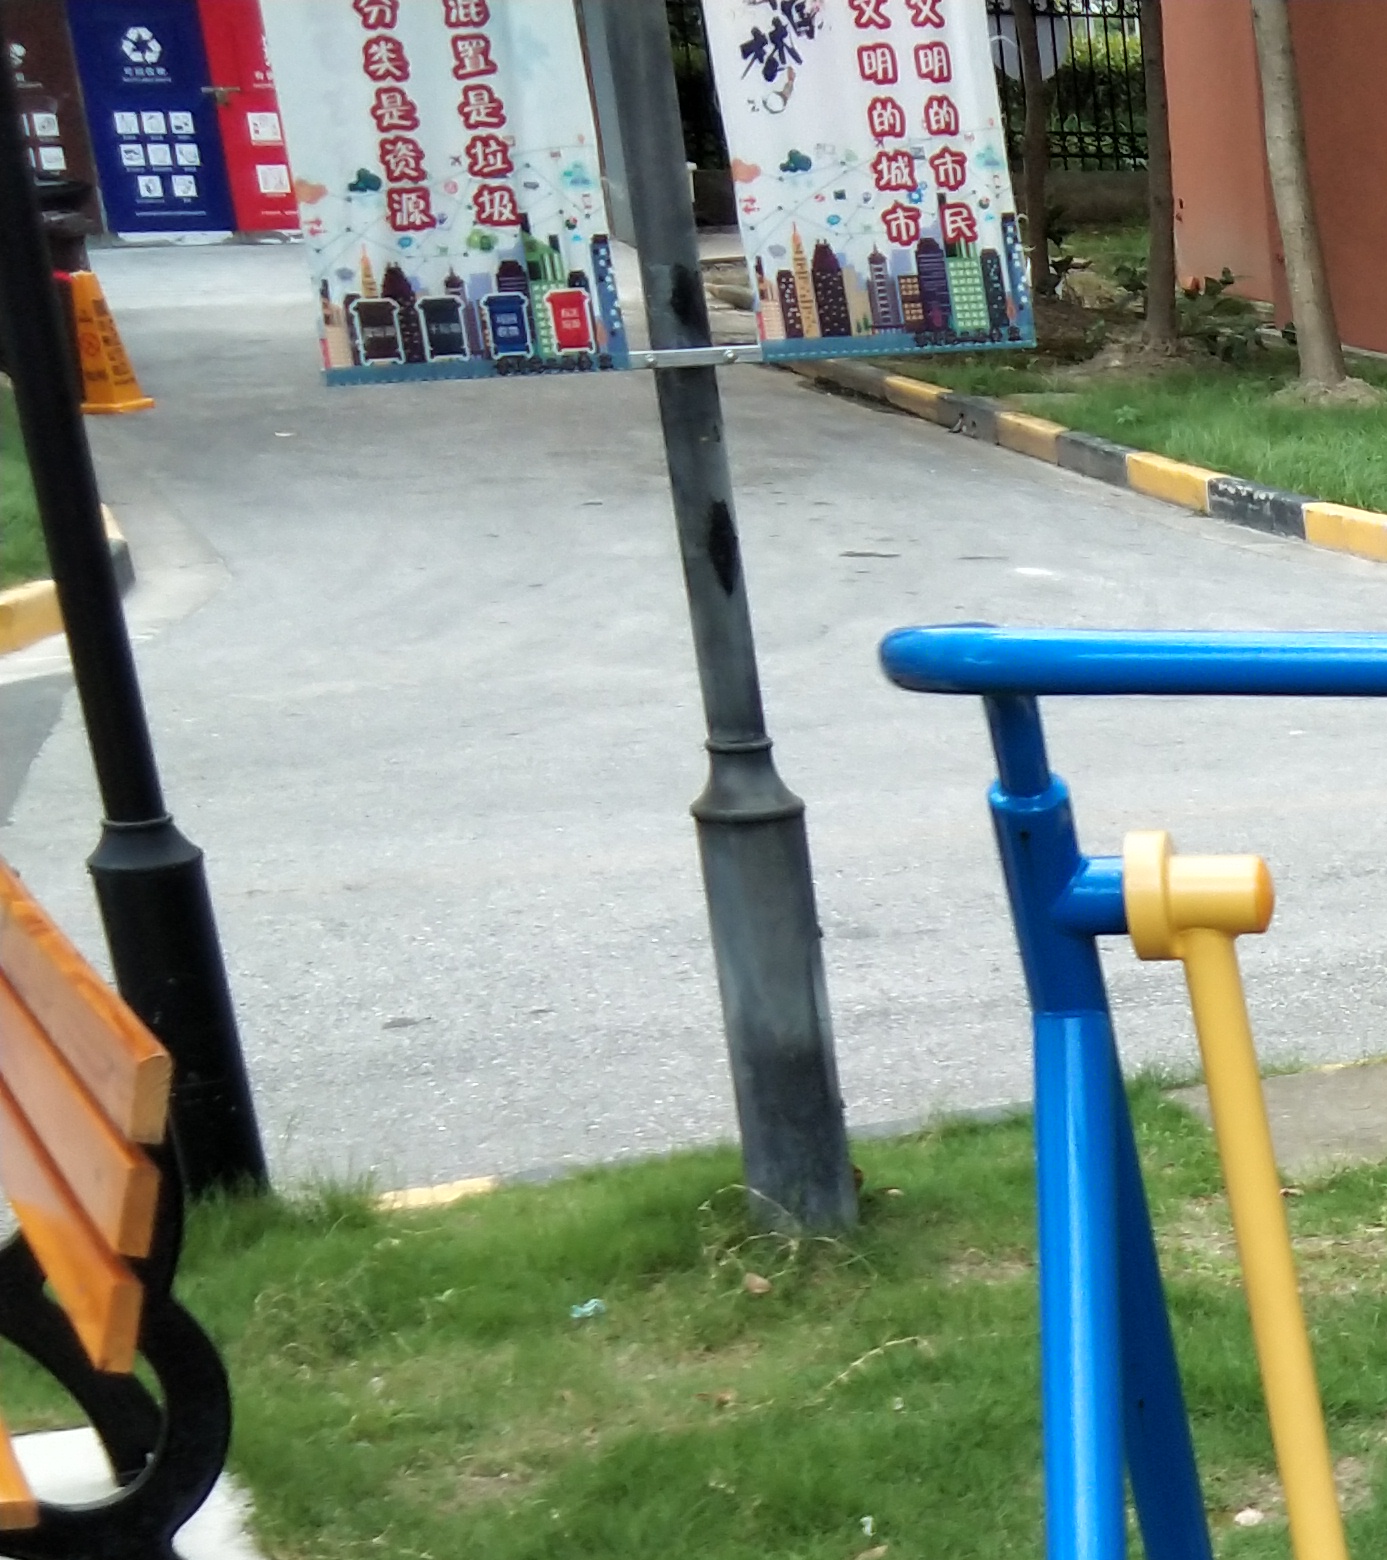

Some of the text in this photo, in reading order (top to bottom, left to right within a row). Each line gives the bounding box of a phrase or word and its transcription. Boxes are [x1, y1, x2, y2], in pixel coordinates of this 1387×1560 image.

[354, 0, 435, 230] 分类是资源
[444, 0, 521, 226] 混置是垃圾
[850, 0, 922, 245] 文明的城市
[907, 0, 977, 242] 文明的市民
